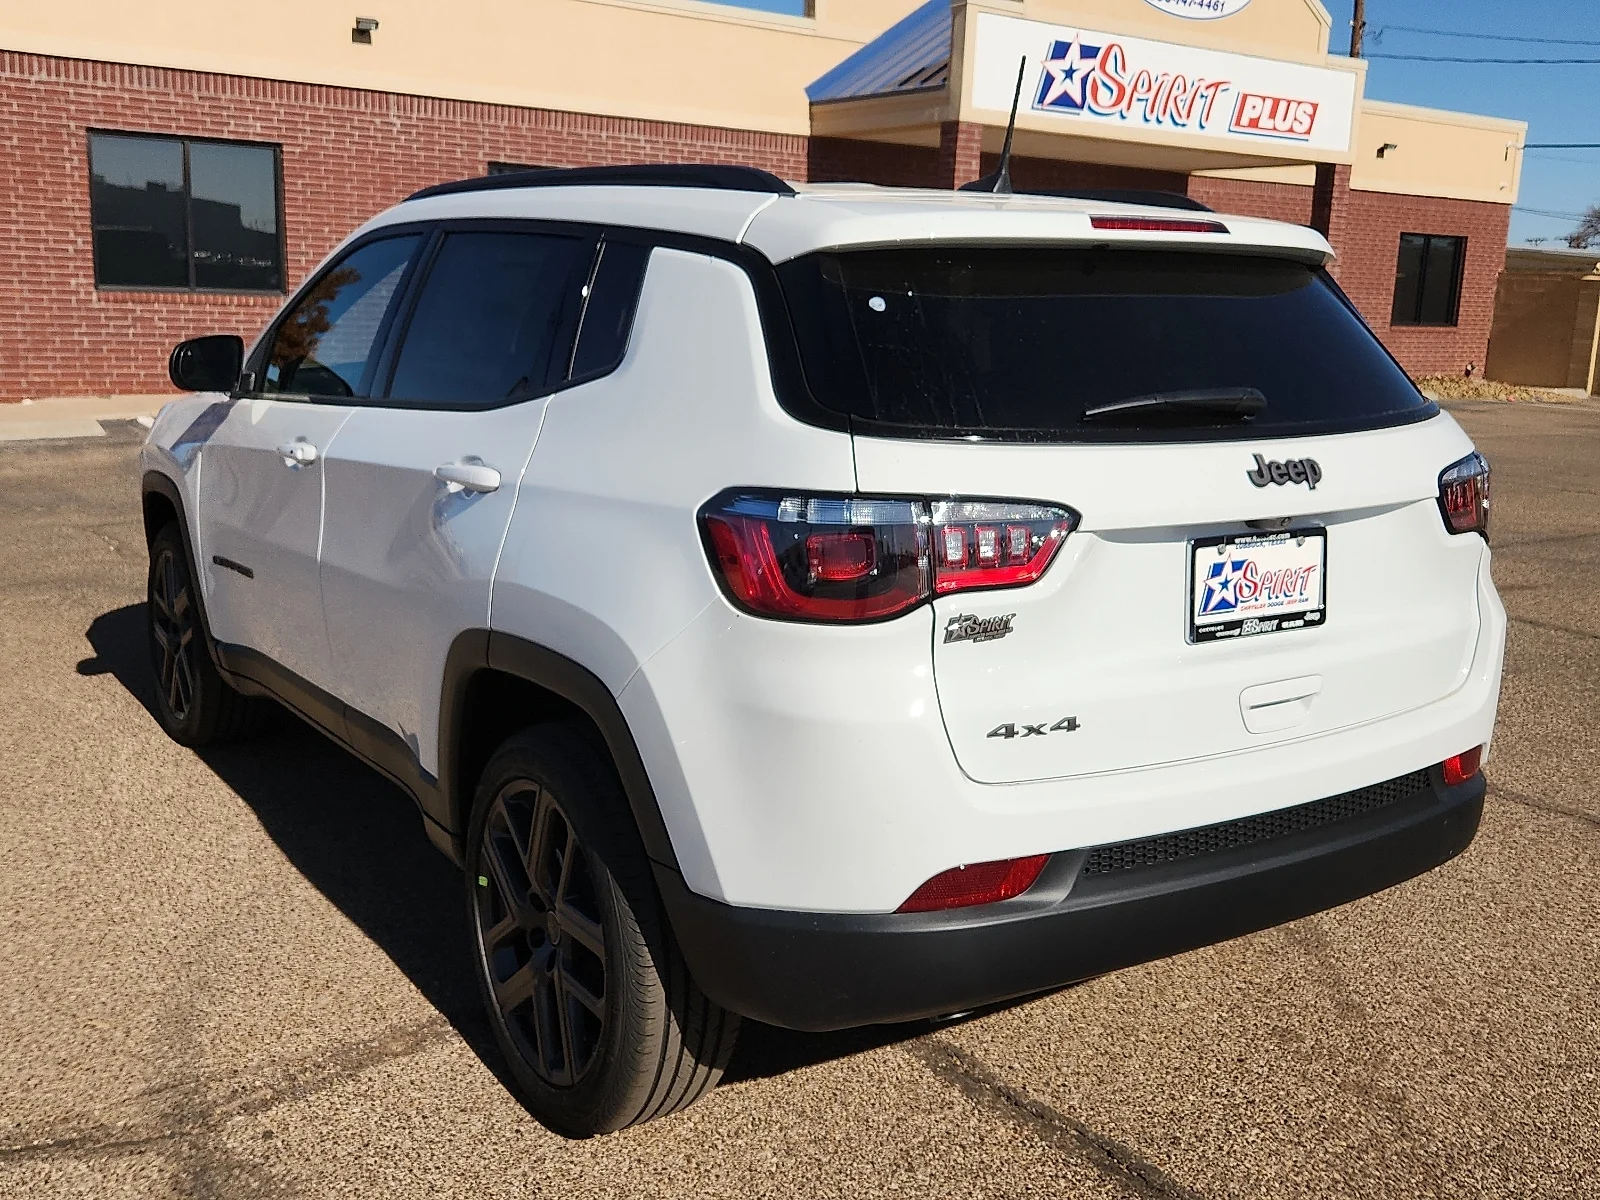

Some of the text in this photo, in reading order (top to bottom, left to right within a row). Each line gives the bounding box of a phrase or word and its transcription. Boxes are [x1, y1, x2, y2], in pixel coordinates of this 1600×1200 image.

[1240, 97, 1315, 135] PLUS
[1246, 453, 1322, 490] Jeep
[986, 715, 1081, 739] 4x4
